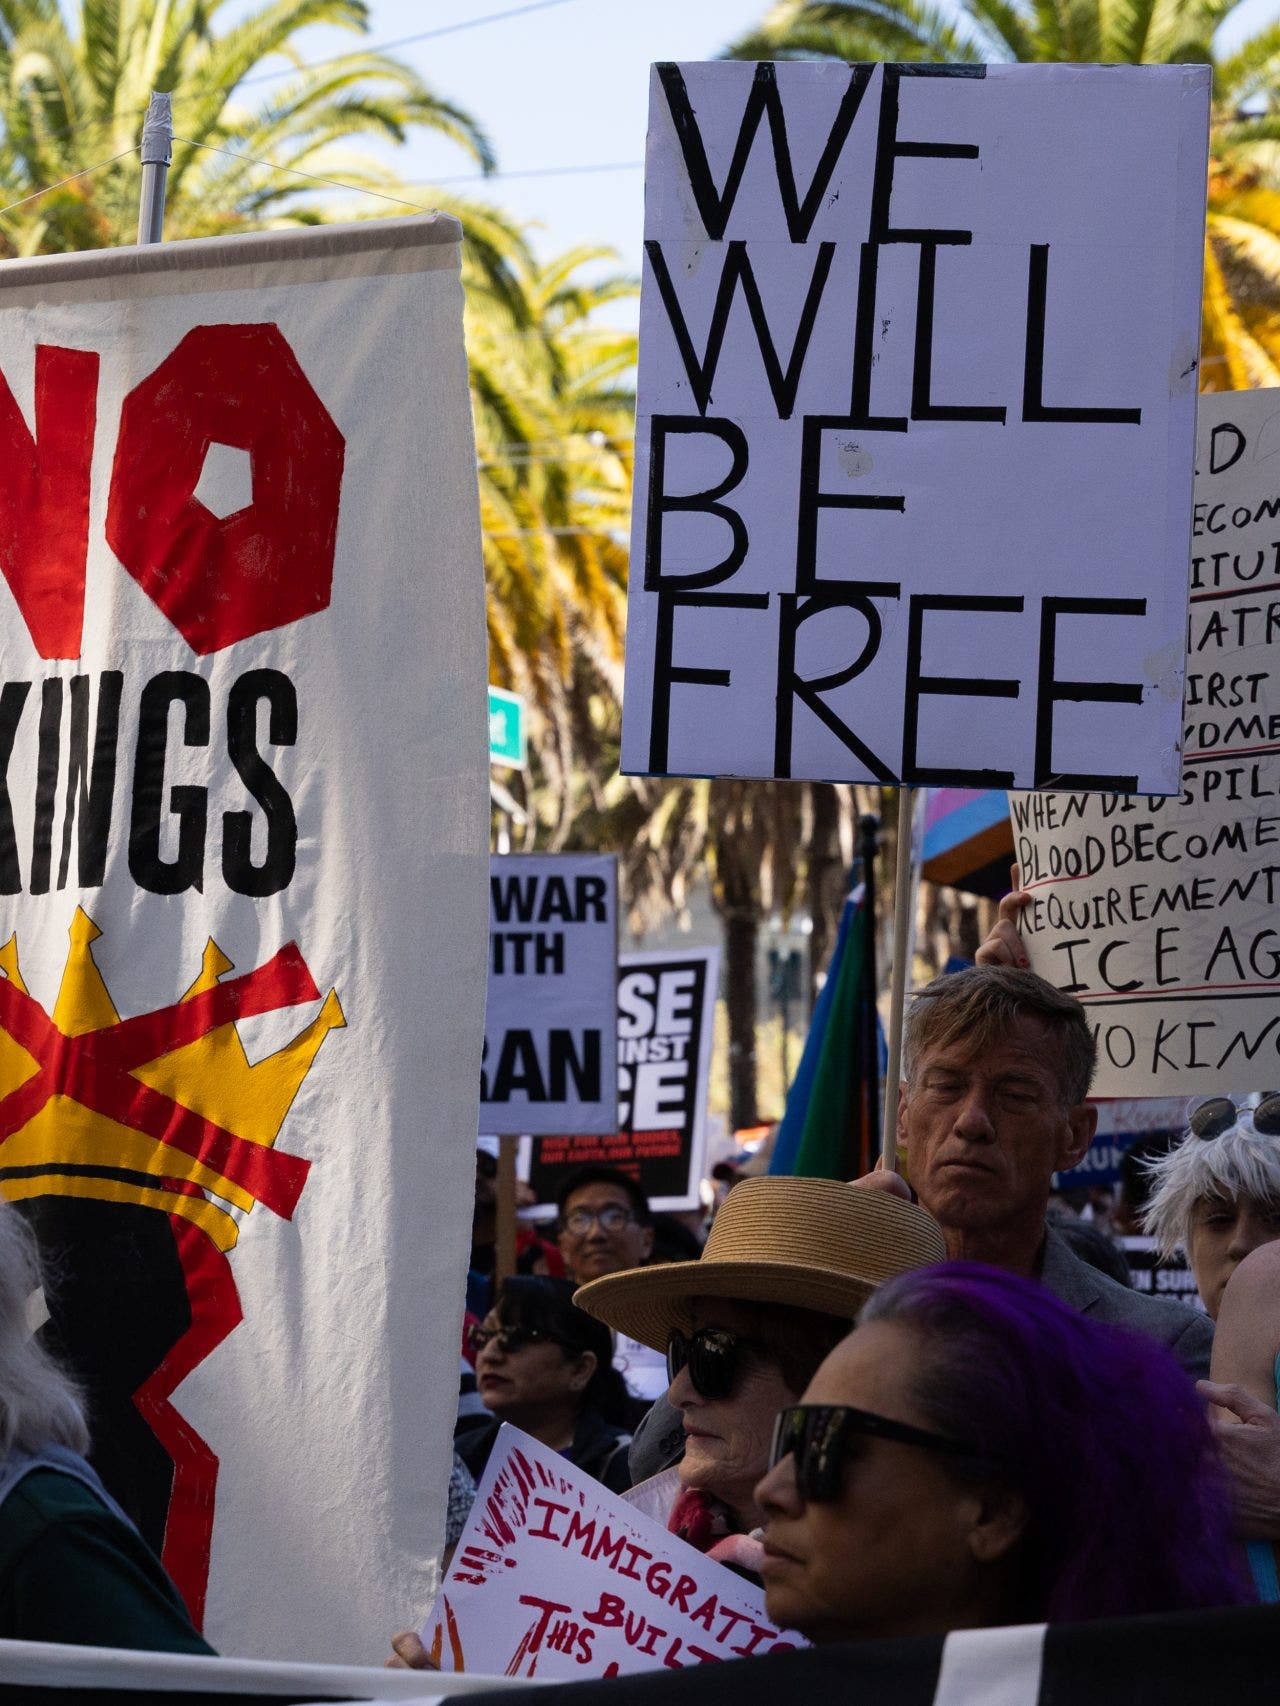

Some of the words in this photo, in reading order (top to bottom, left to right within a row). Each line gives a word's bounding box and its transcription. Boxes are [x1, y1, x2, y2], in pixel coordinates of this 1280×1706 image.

[654, 62, 986, 244] WE
[644, 241, 1141, 425] WILL
[644, 414, 908, 598] BE
[648, 590, 1146, 788] FREE
[1187, 671, 1270, 708] IRST
[1013, 793, 1089, 833] WHEN
[1179, 765, 1280, 806] SPIL
[1019, 835, 1105, 887] BLOOD
[1111, 817, 1280, 868] BECOME
[490, 875, 607, 923] WAR
[490, 931, 564, 975] ITH
[1052, 927, 1180, 993] ICE
[1204, 926, 1280, 981] AG
[1152, 1017, 1280, 1074] KIN
[528, 1497, 797, 1657] IMMIGRATI
[518, 1594, 597, 1664] THIS
